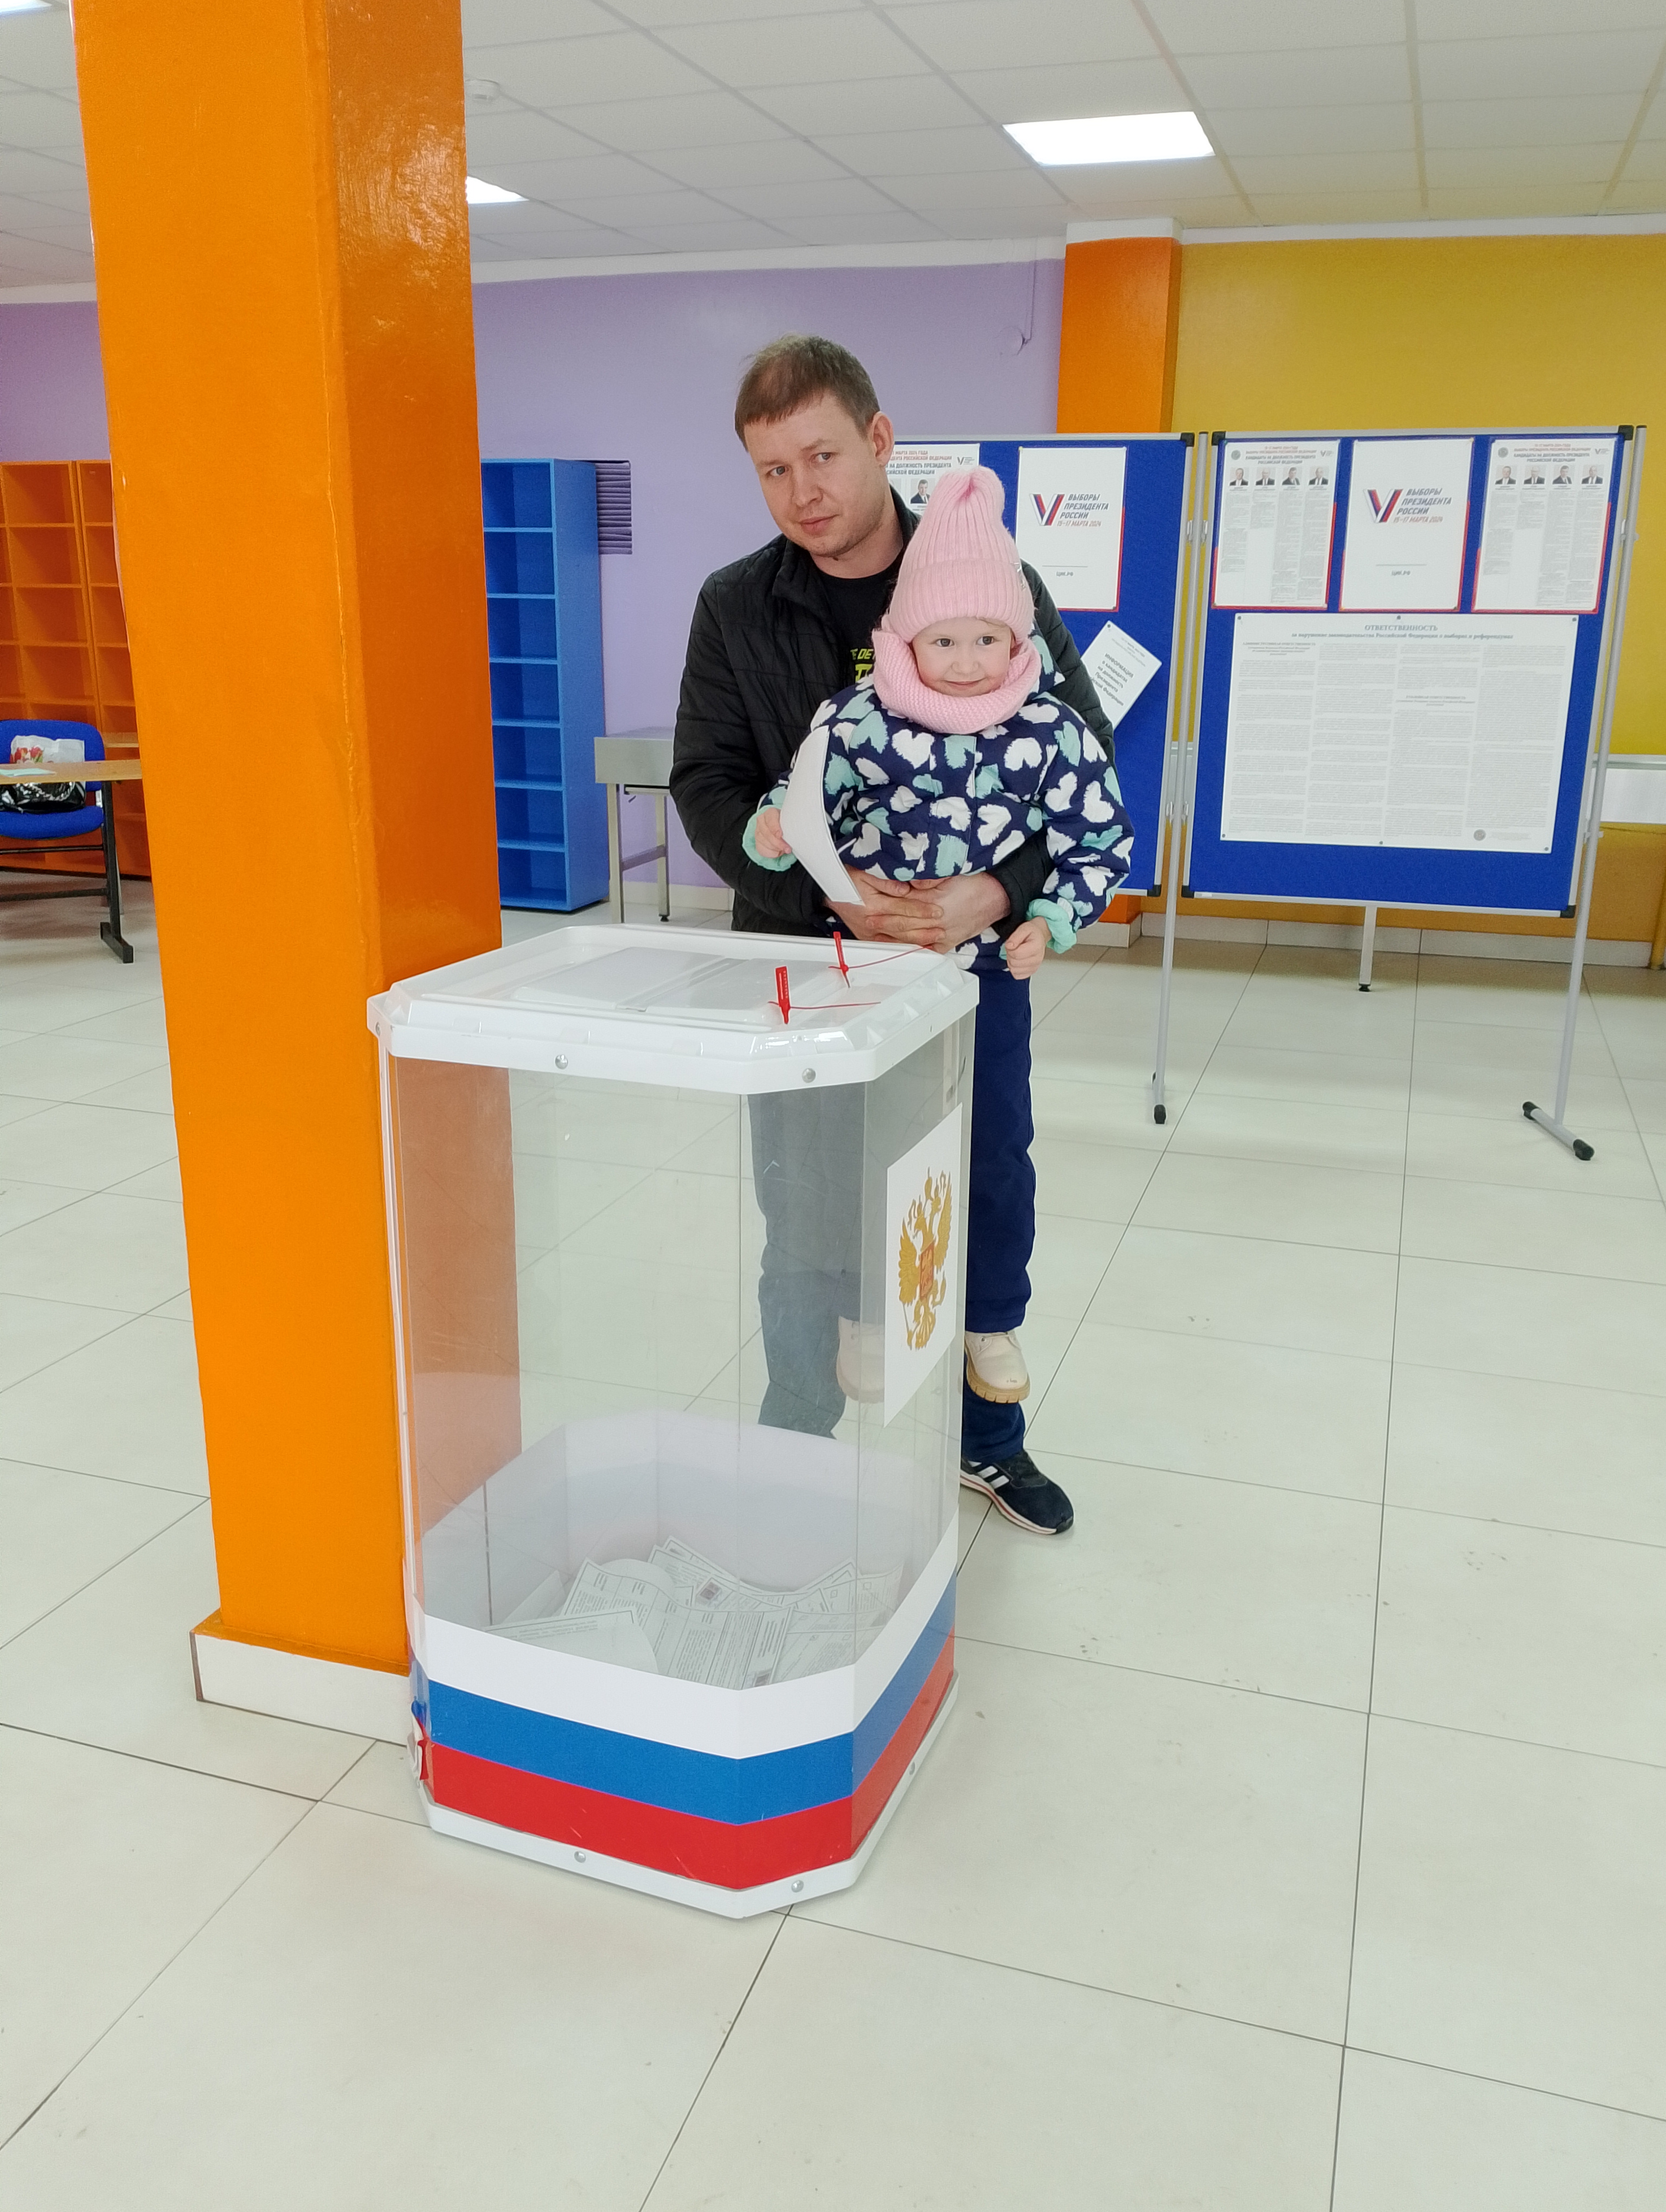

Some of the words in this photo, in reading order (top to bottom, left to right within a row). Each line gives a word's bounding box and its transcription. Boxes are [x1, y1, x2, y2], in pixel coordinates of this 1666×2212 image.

[1406, 488, 1443, 496] ВЫБОРЫ
[1401, 497, 1452, 506] ПРЕЗИДЕНТА
[1105, 653, 1133, 678] ИНФОРМАЦИЯ
